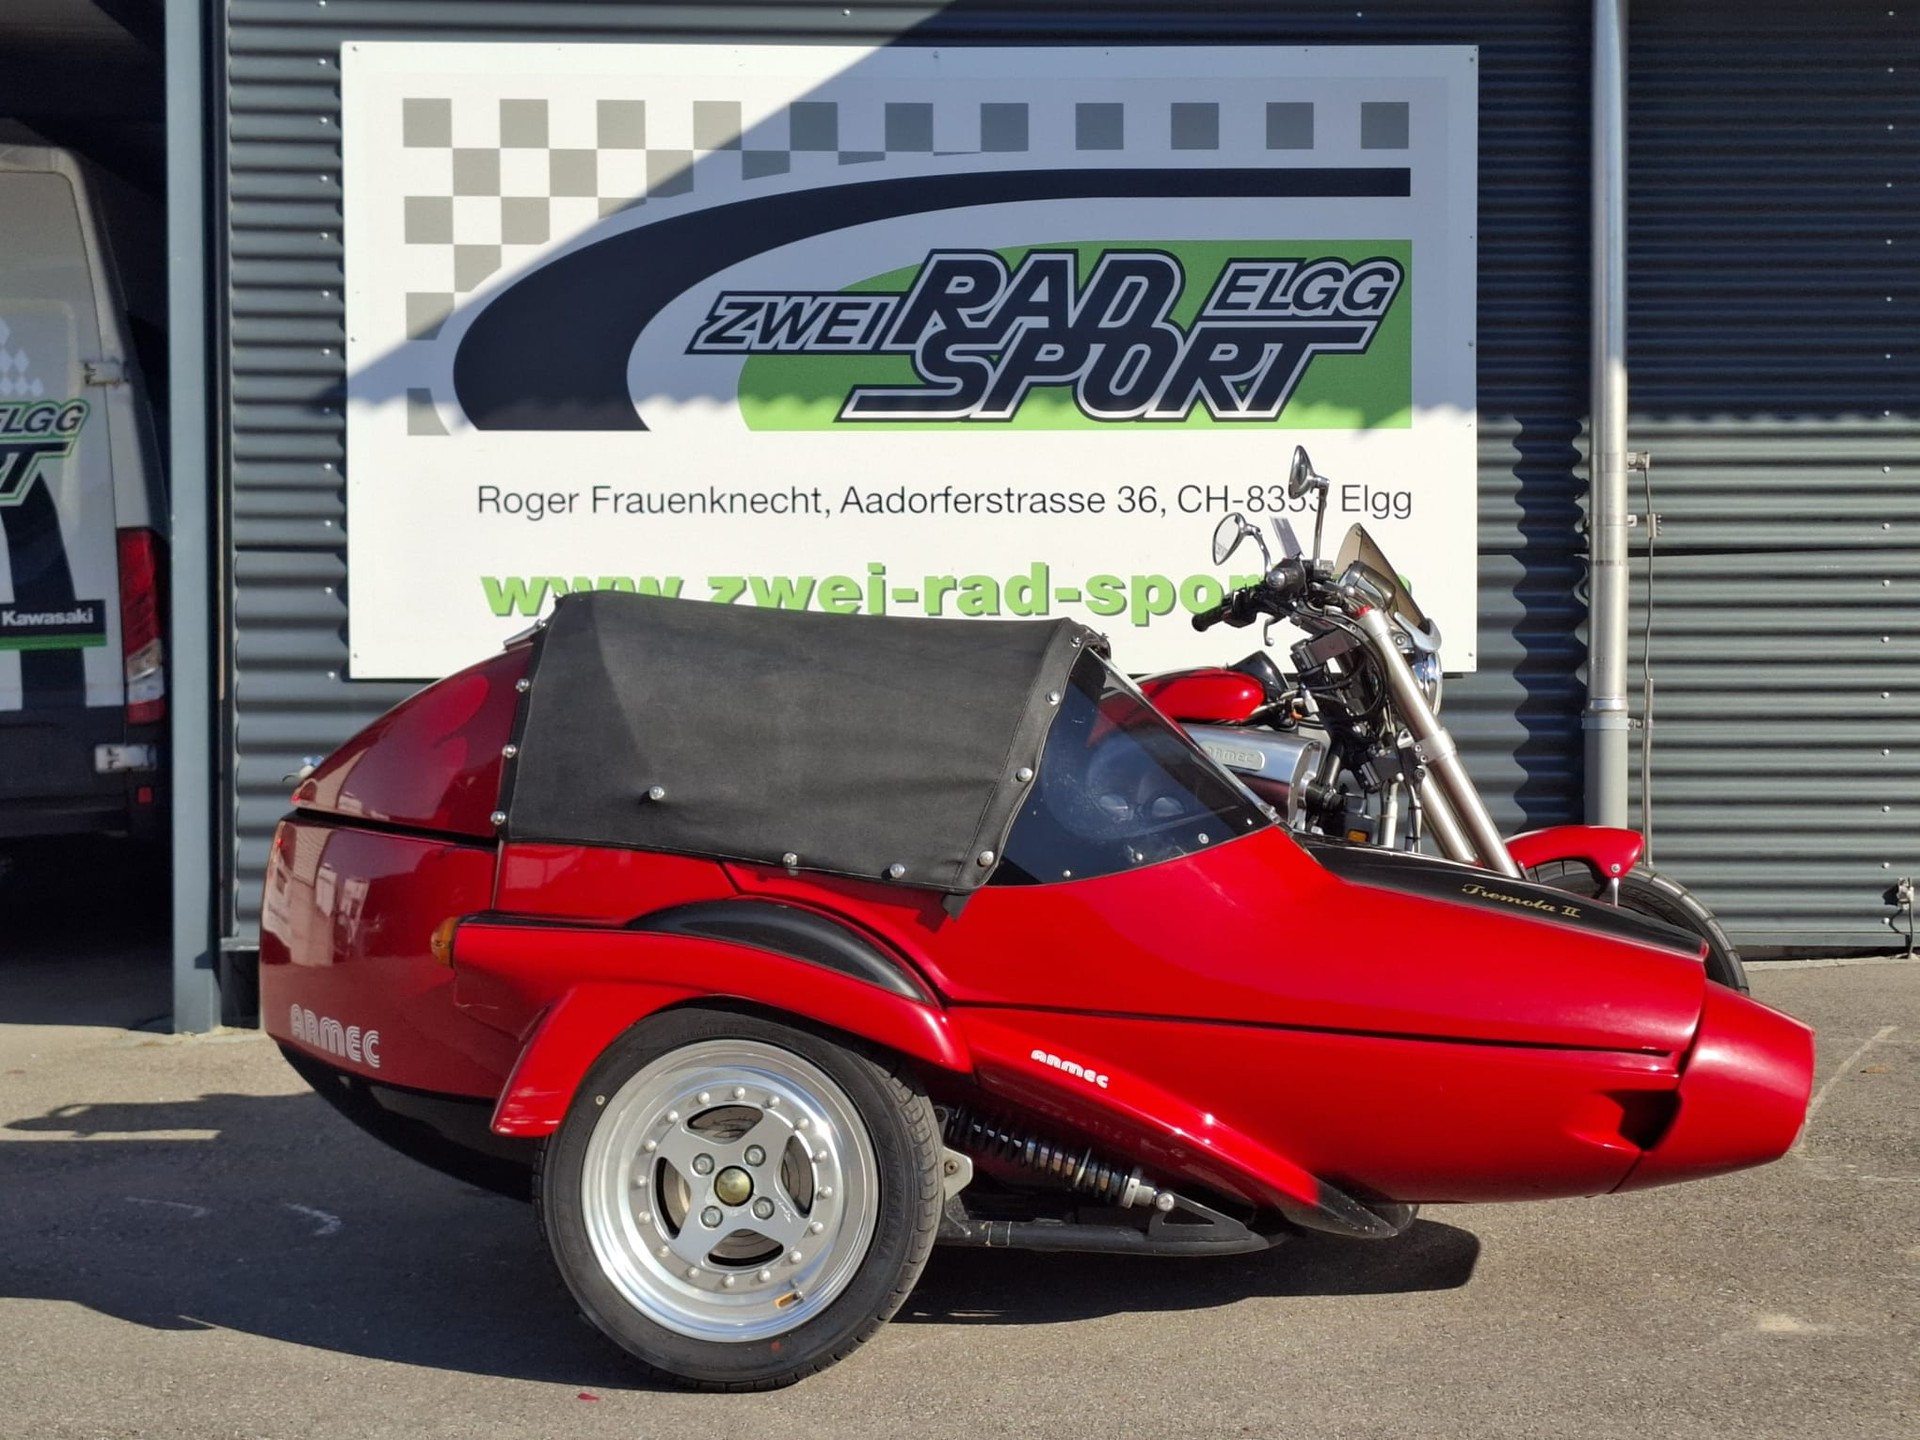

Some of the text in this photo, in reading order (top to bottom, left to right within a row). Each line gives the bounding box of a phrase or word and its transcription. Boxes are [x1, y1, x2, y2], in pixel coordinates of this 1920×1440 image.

[1203, 257, 1402, 317] ELGG
[837, 320, 1377, 420] SPORT
[478, 485, 578, 520] Roger
[592, 485, 829, 518] Frauenknecht,
[841, 485, 1105, 514] Aadorferstrasse
[1117, 485, 1166, 517] 36,
[1341, 484, 1412, 520] Elgg
[1, 607, 94, 627] Kawasaki
[1461, 883, 1582, 918] Tremola II
[290, 1003, 381, 1069] ARMEC
[1030, 1049, 1109, 1089] ARMEC
